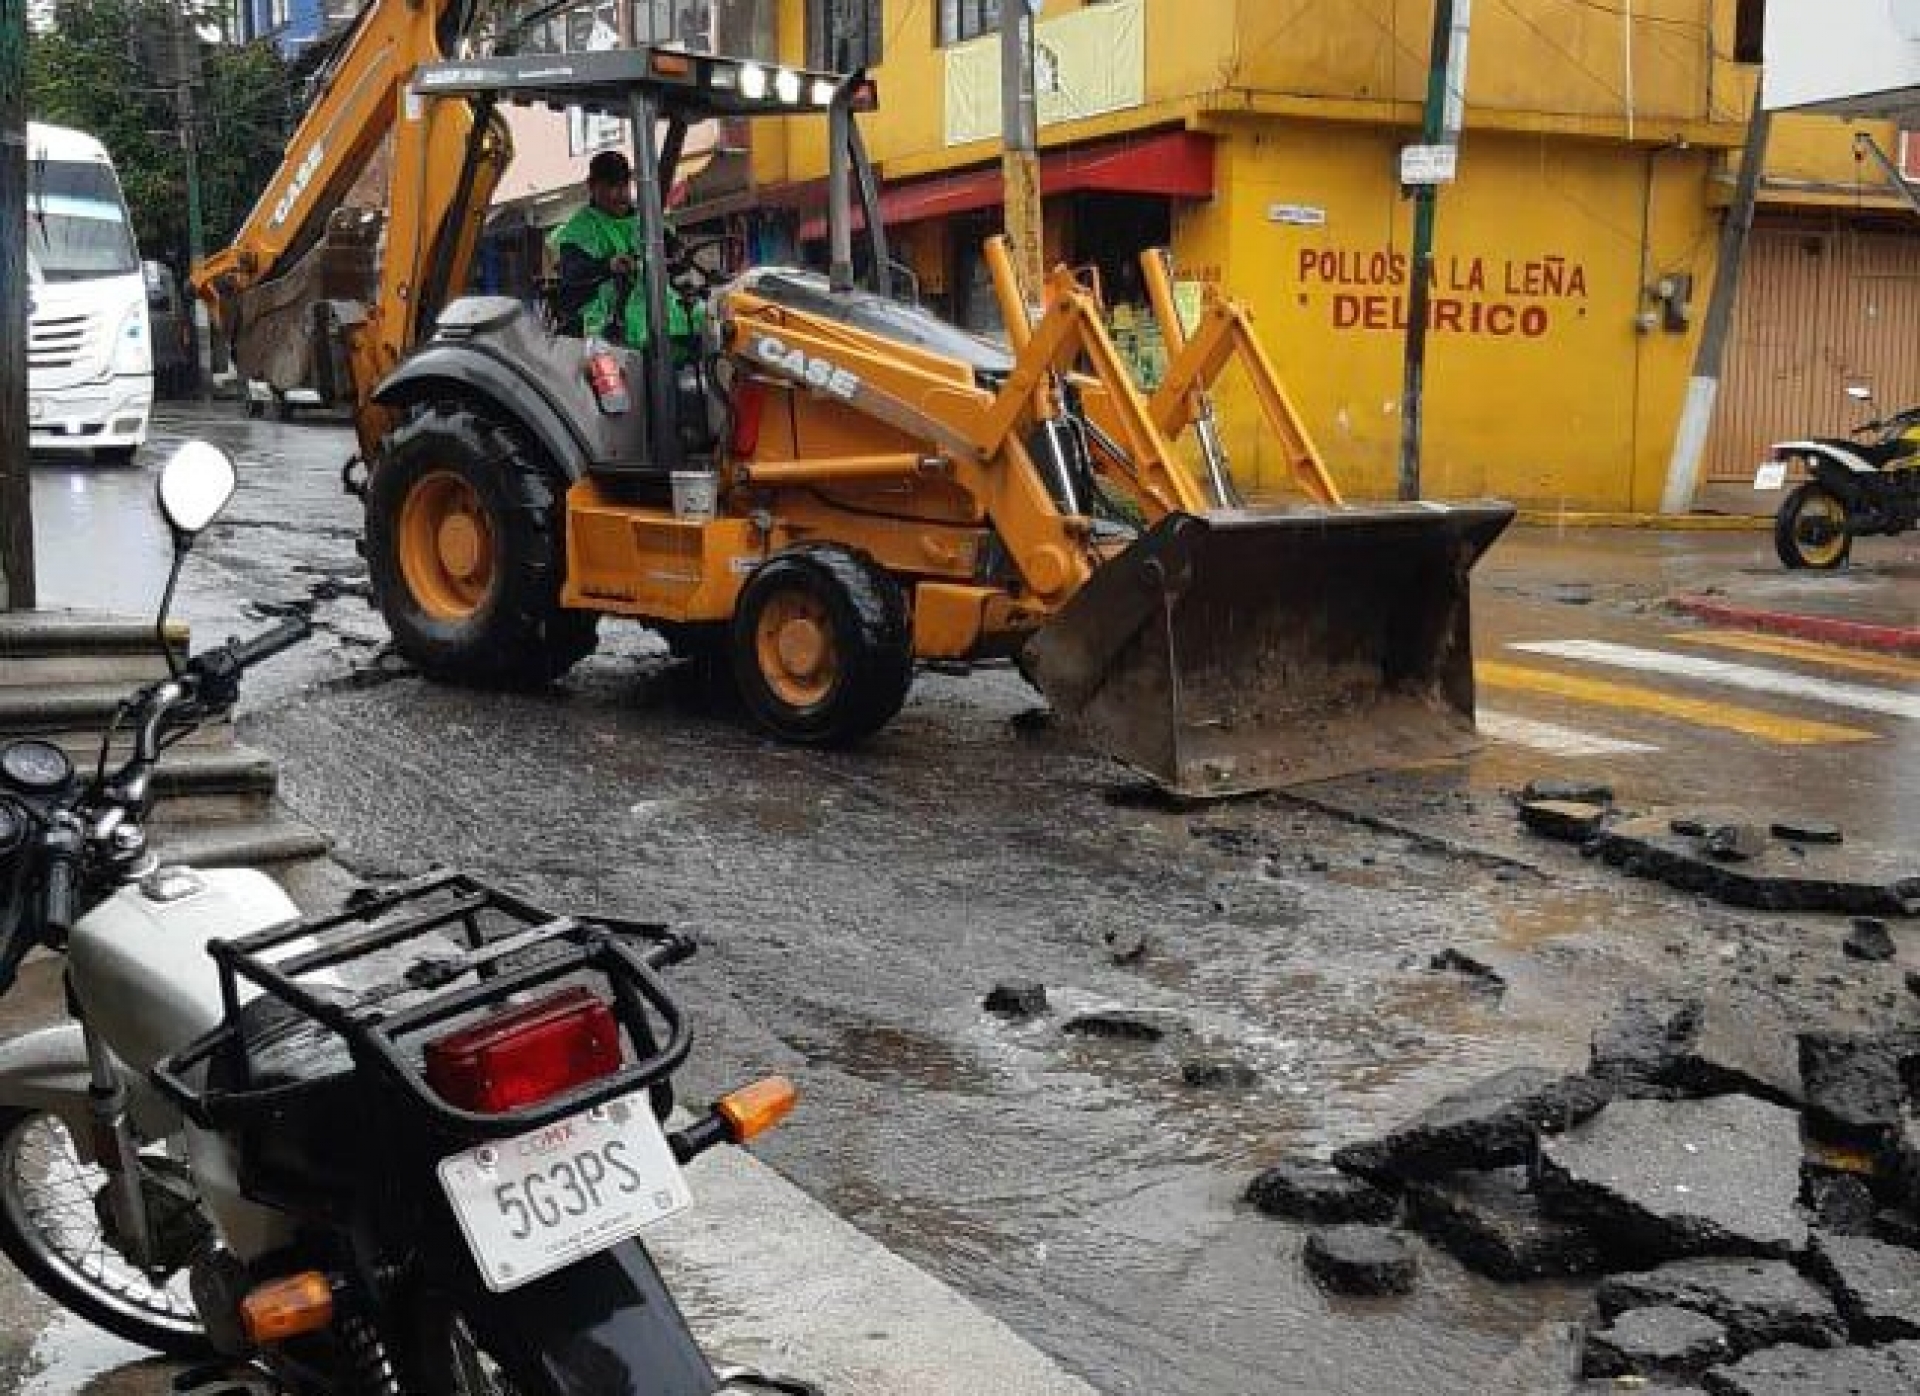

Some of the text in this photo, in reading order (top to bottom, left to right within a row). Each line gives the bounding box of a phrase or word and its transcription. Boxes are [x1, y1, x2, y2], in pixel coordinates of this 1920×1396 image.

[1299, 249, 1405, 285] POLLOS
[1451, 256, 1486, 291] LA
[1504, 255, 1587, 297] LEÑA
[757, 336, 860, 398] CASE
[494, 1140, 641, 1240] 5G3PS
